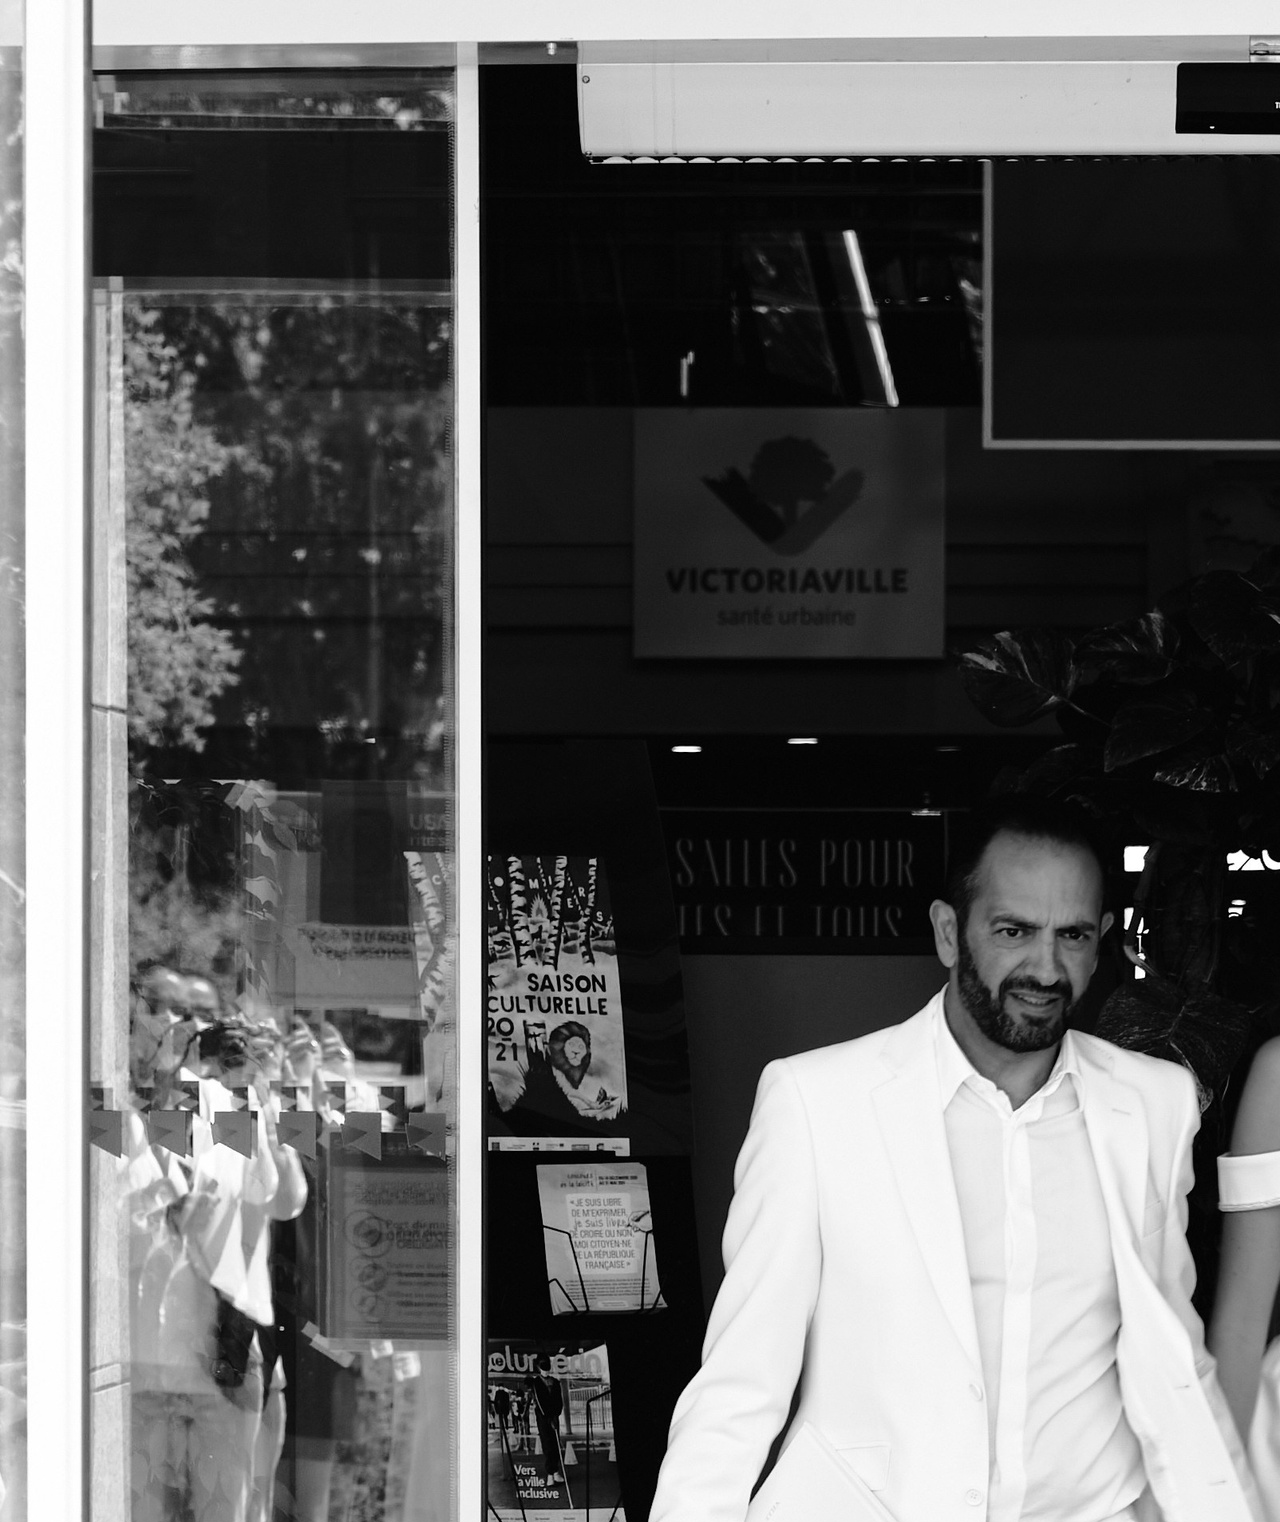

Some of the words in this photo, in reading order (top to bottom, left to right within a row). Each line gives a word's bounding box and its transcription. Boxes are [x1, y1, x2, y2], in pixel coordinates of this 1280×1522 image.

[665, 567, 909, 594] VICTORIAVILLE
[717, 605, 774, 626] santé
[777, 606, 856, 626] urbaine
[675, 837, 799, 888] SALLES
[820, 837, 914, 888] POUR
[527, 972, 607, 993] SAISON
[488, 995, 608, 1015] CULTURELLE
[496, 1042, 518, 1061] 21
[585, 1198, 601, 1207] SUIS
[603, 1198, 622, 1207] LIBRE
[571, 1209, 580, 1218] DE
[585, 1220, 604, 1228] suis
[580, 1229, 604, 1238] CROIRE
[604, 1229, 615, 1238] OU
[590, 1239, 632, 1248] CITOYEN-NE
[584, 1250, 593, 1259] LA
[594, 1248, 636, 1259] RÉPUBLIQUE
[585, 1260, 625, 1271] FRANÇAISE
[514, 1464, 536, 1476] Vers
[525, 1476, 545, 1486] ville
